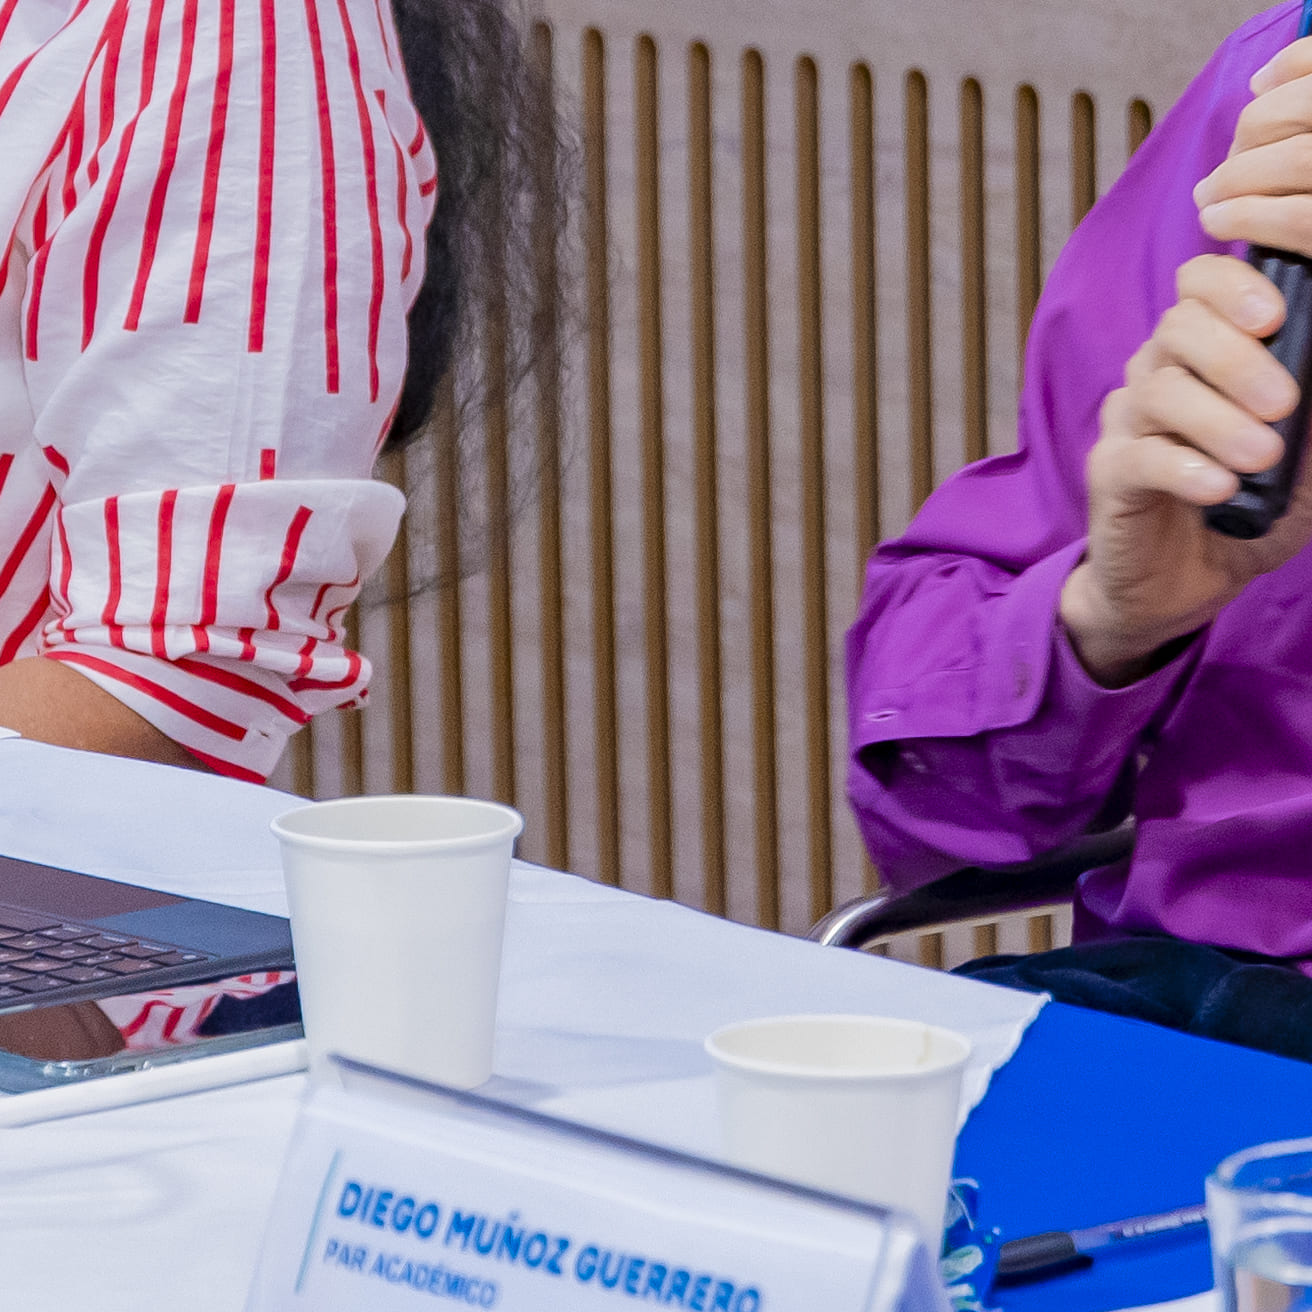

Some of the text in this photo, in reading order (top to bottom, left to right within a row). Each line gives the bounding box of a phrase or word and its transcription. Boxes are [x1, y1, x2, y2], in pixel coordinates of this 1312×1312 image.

[323, 1238, 368, 1272] PAR
[337, 1181, 761, 1312] DIEGO MUÑOZ GUERRERO
